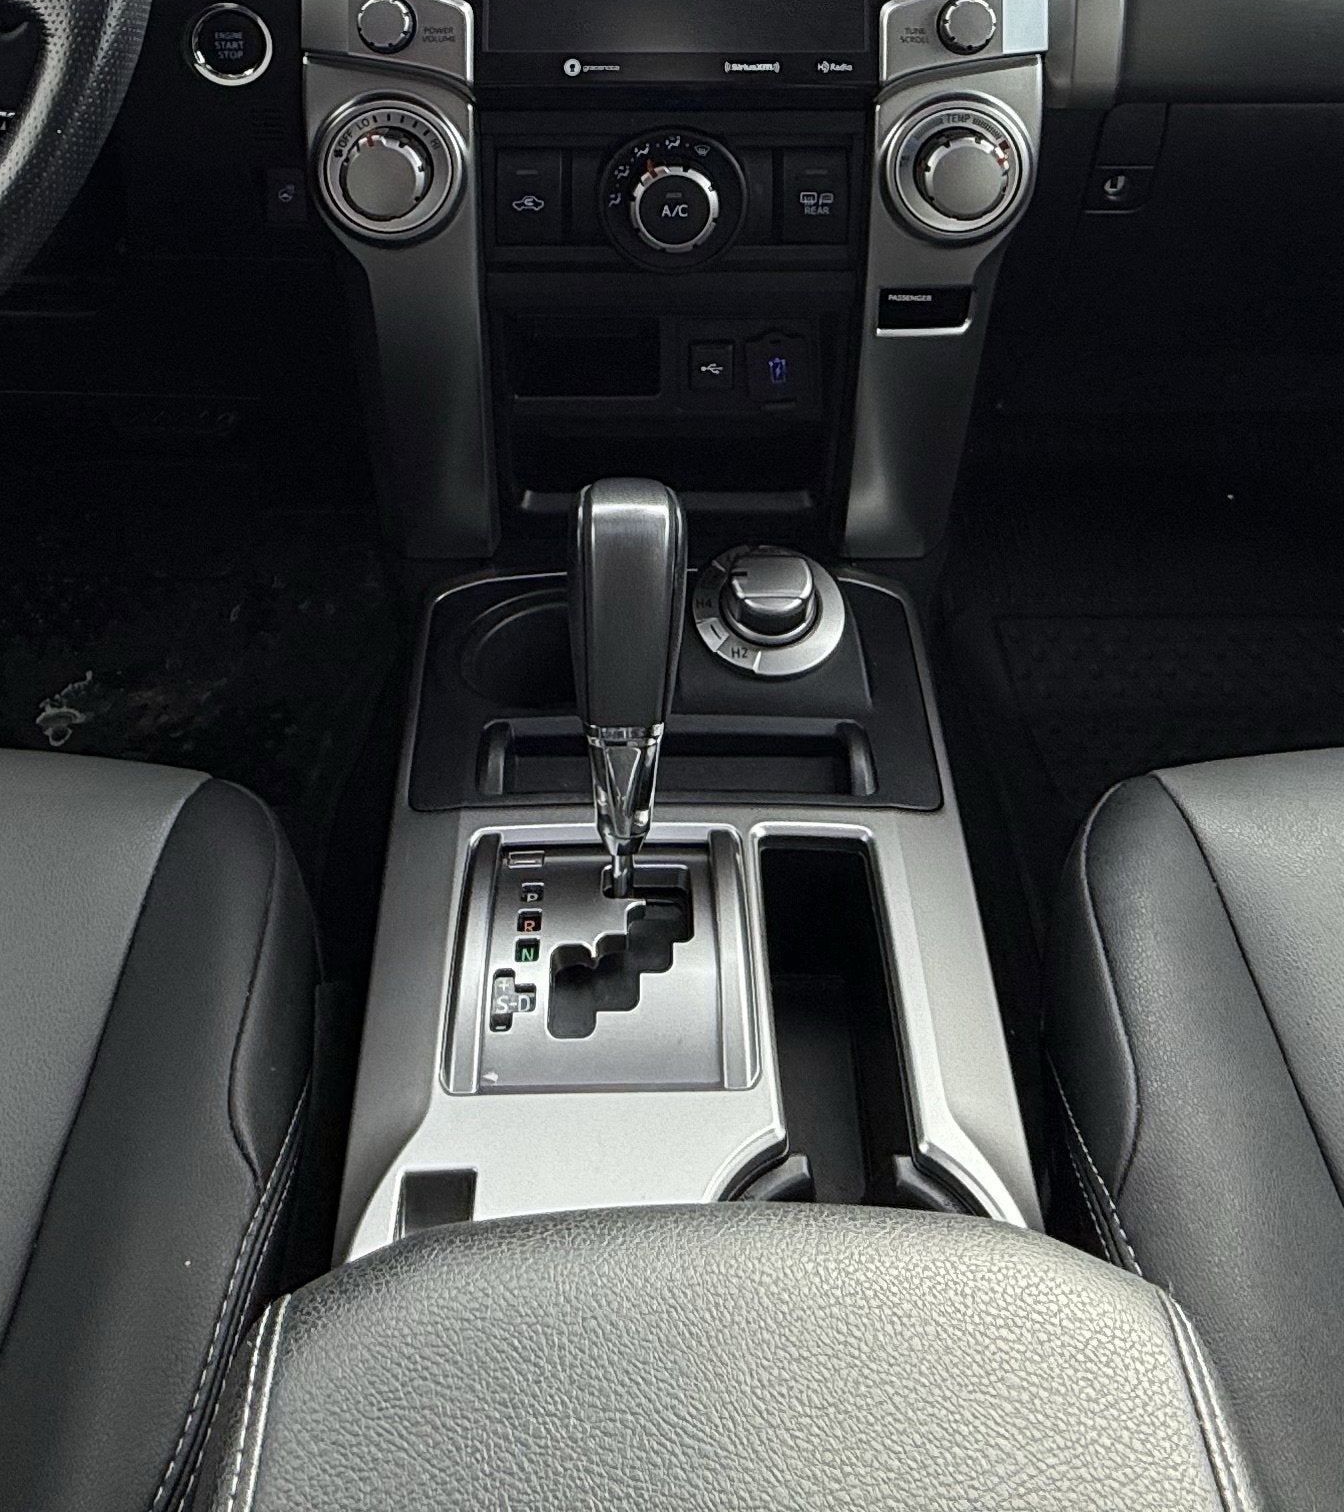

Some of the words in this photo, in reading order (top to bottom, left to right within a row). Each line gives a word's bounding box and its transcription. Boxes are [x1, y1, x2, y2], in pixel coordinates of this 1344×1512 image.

[214, 40, 245, 50] START
[217, 50, 244, 59] STOP
[356, 117, 370, 130] LO
[945, 112, 972, 124] TEMP
[337, 129, 354, 149] OFF
[660, 203, 689, 218] A/C
[804, 206, 831, 215] REAR
[888, 294, 933, 302] PASSENGER
[696, 598, 712, 609] H4
[731, 647, 749, 658] H2
[526, 892, 539, 903] P
[524, 920, 536, 932] R
[521, 947, 535, 962] N
